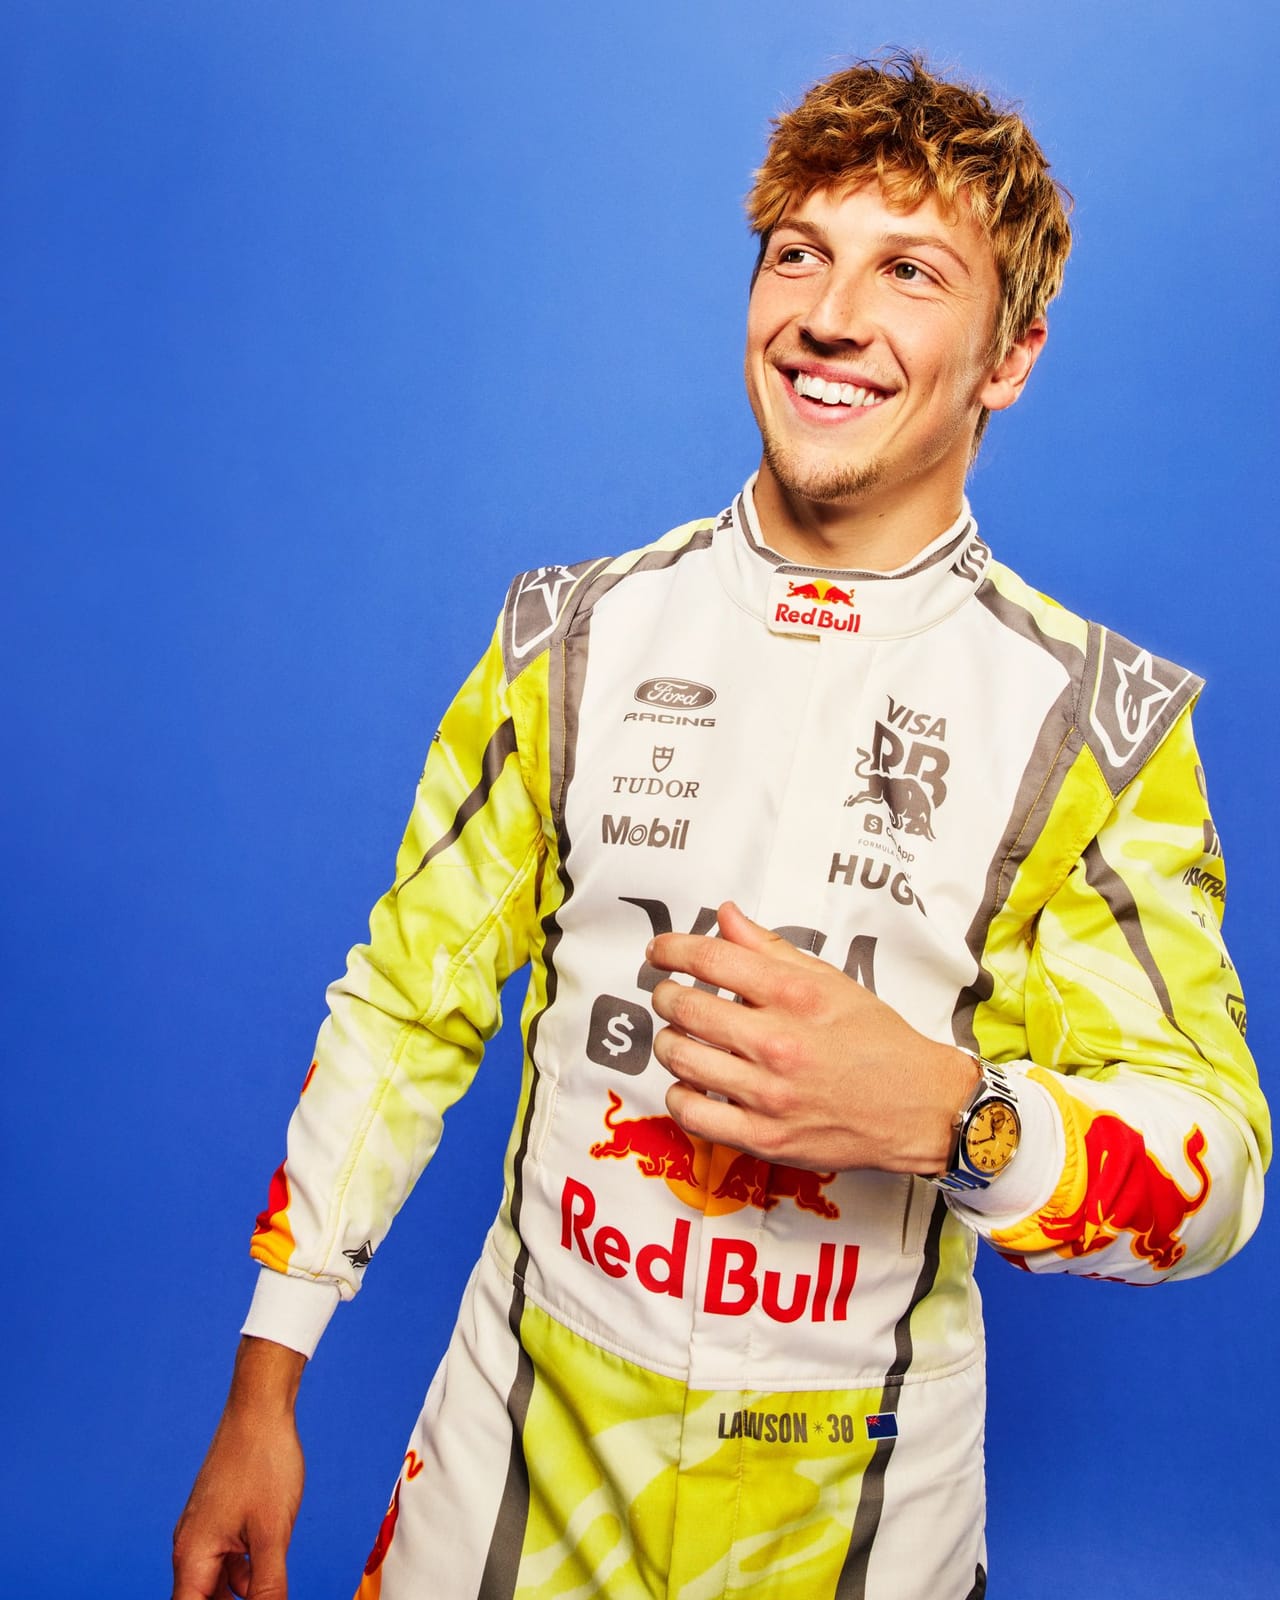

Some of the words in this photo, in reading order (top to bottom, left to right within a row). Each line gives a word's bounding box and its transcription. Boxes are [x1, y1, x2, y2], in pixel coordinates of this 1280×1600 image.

[775, 603, 816, 626] Red
[817, 610, 861, 633] Bull
[647, 682, 701, 706] Ford
[623, 712, 716, 727] RACING
[886, 694, 947, 742] VISA
[613, 776, 699, 798] TUDOR
[601, 814, 690, 850] Mobil
[560, 1176, 692, 1300] Red
[703, 1237, 860, 1323] Bull
[718, 1410, 808, 1443] LAWSON
[827, 1413, 854, 1444] 30
